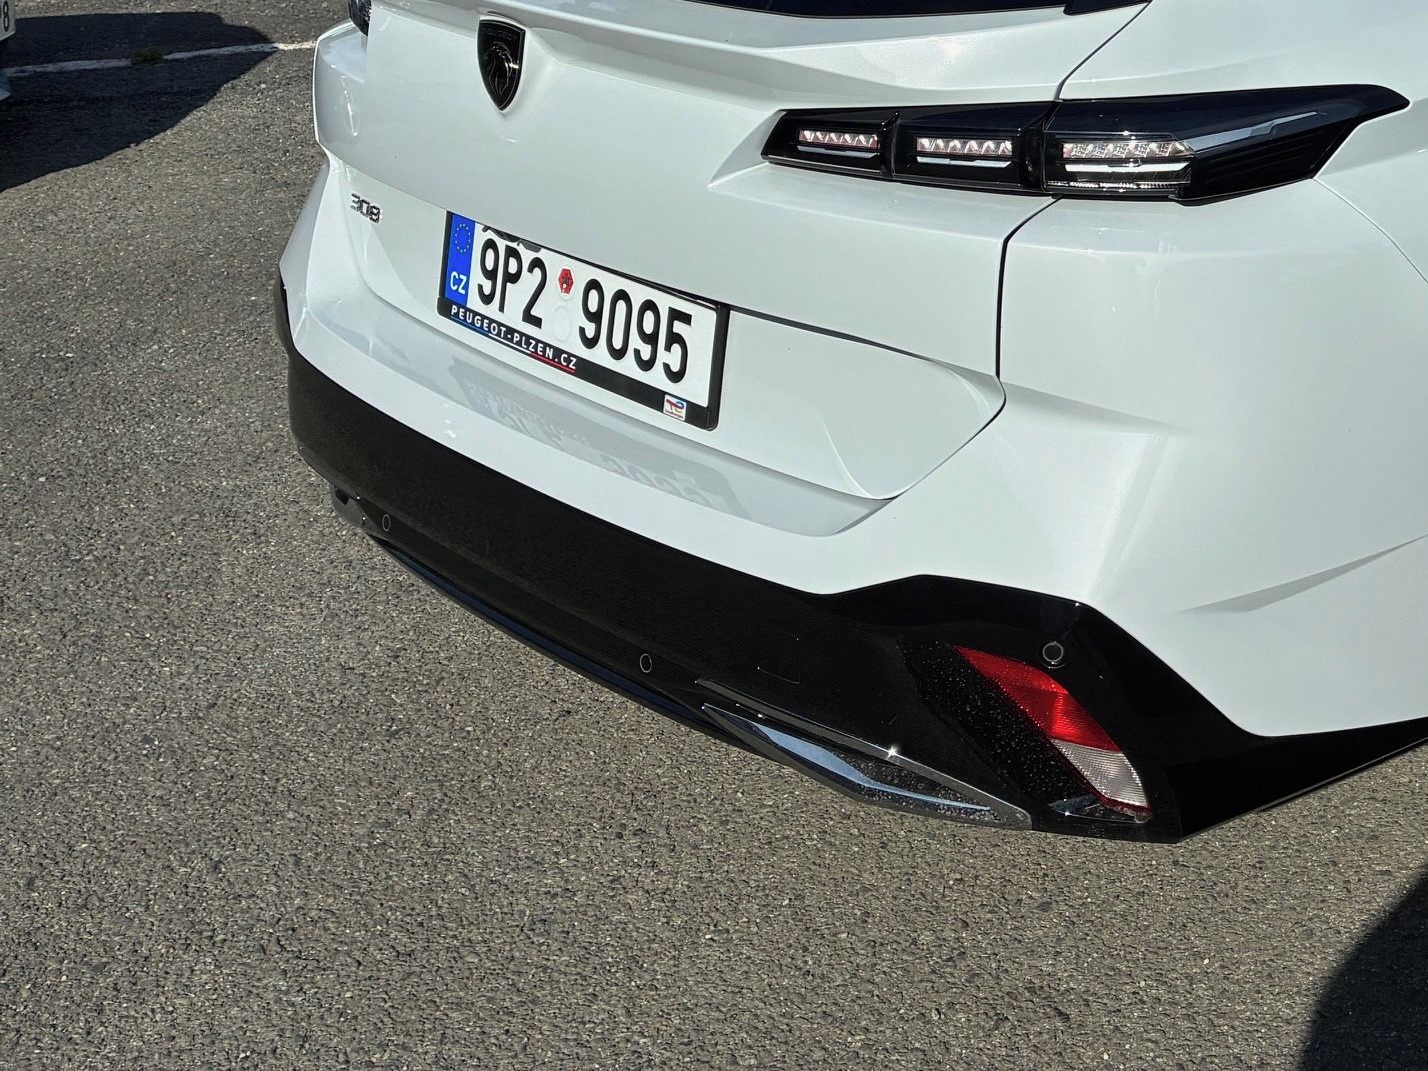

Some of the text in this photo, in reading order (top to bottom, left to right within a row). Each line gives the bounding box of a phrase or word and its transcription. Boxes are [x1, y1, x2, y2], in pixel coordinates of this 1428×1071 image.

[350, 193, 381, 224] 308
[450, 271, 467, 295] CZ
[477, 237, 692, 384] 9P2 9095
[451, 305, 578, 369] PEUGEOT-PLZEN.CZ
